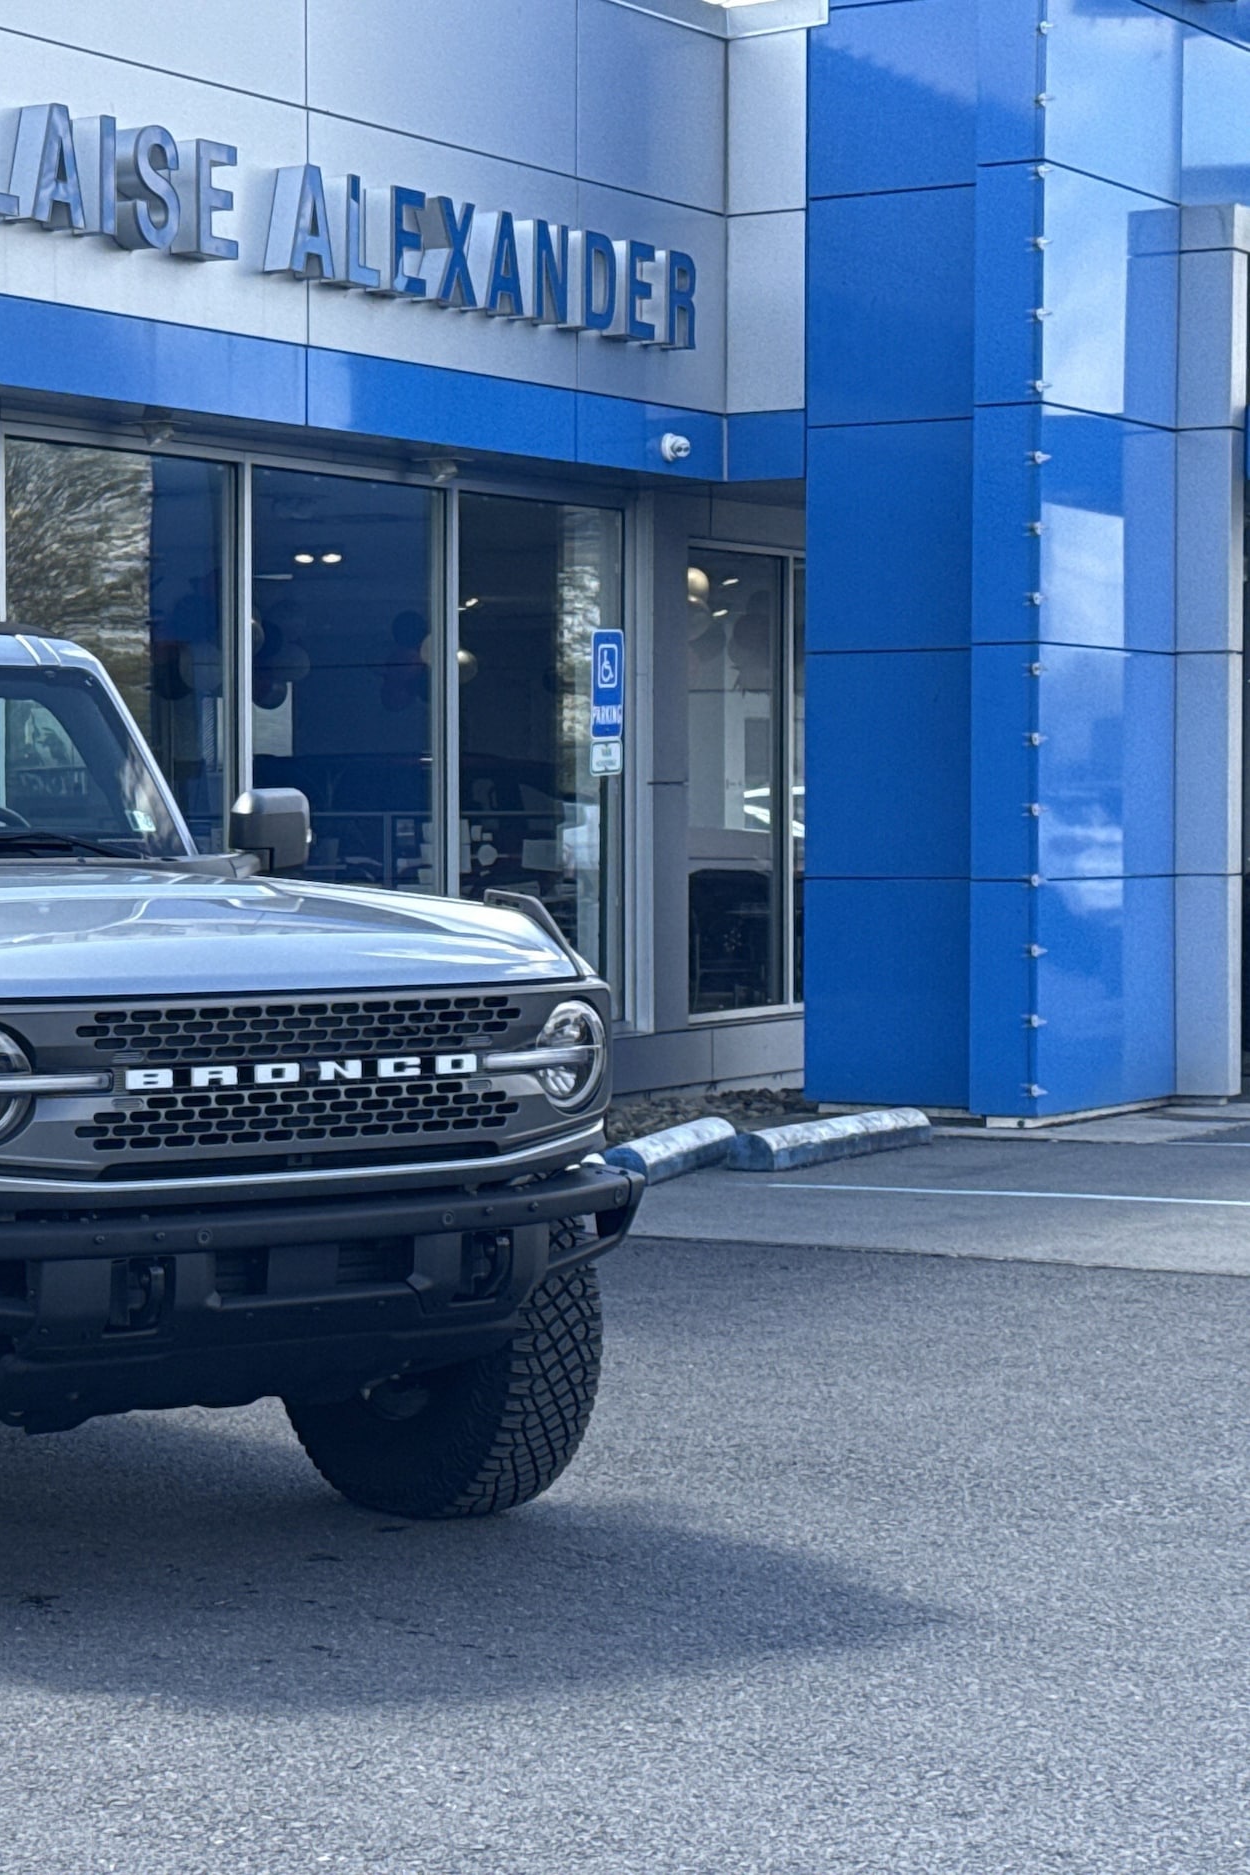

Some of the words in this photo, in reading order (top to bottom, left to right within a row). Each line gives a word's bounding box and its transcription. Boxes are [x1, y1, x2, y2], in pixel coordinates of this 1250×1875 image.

[263, 164, 697, 352] ALEXANDER
[592, 704, 622, 726] PARKING
[125, 1053, 478, 1091] BRONCO
